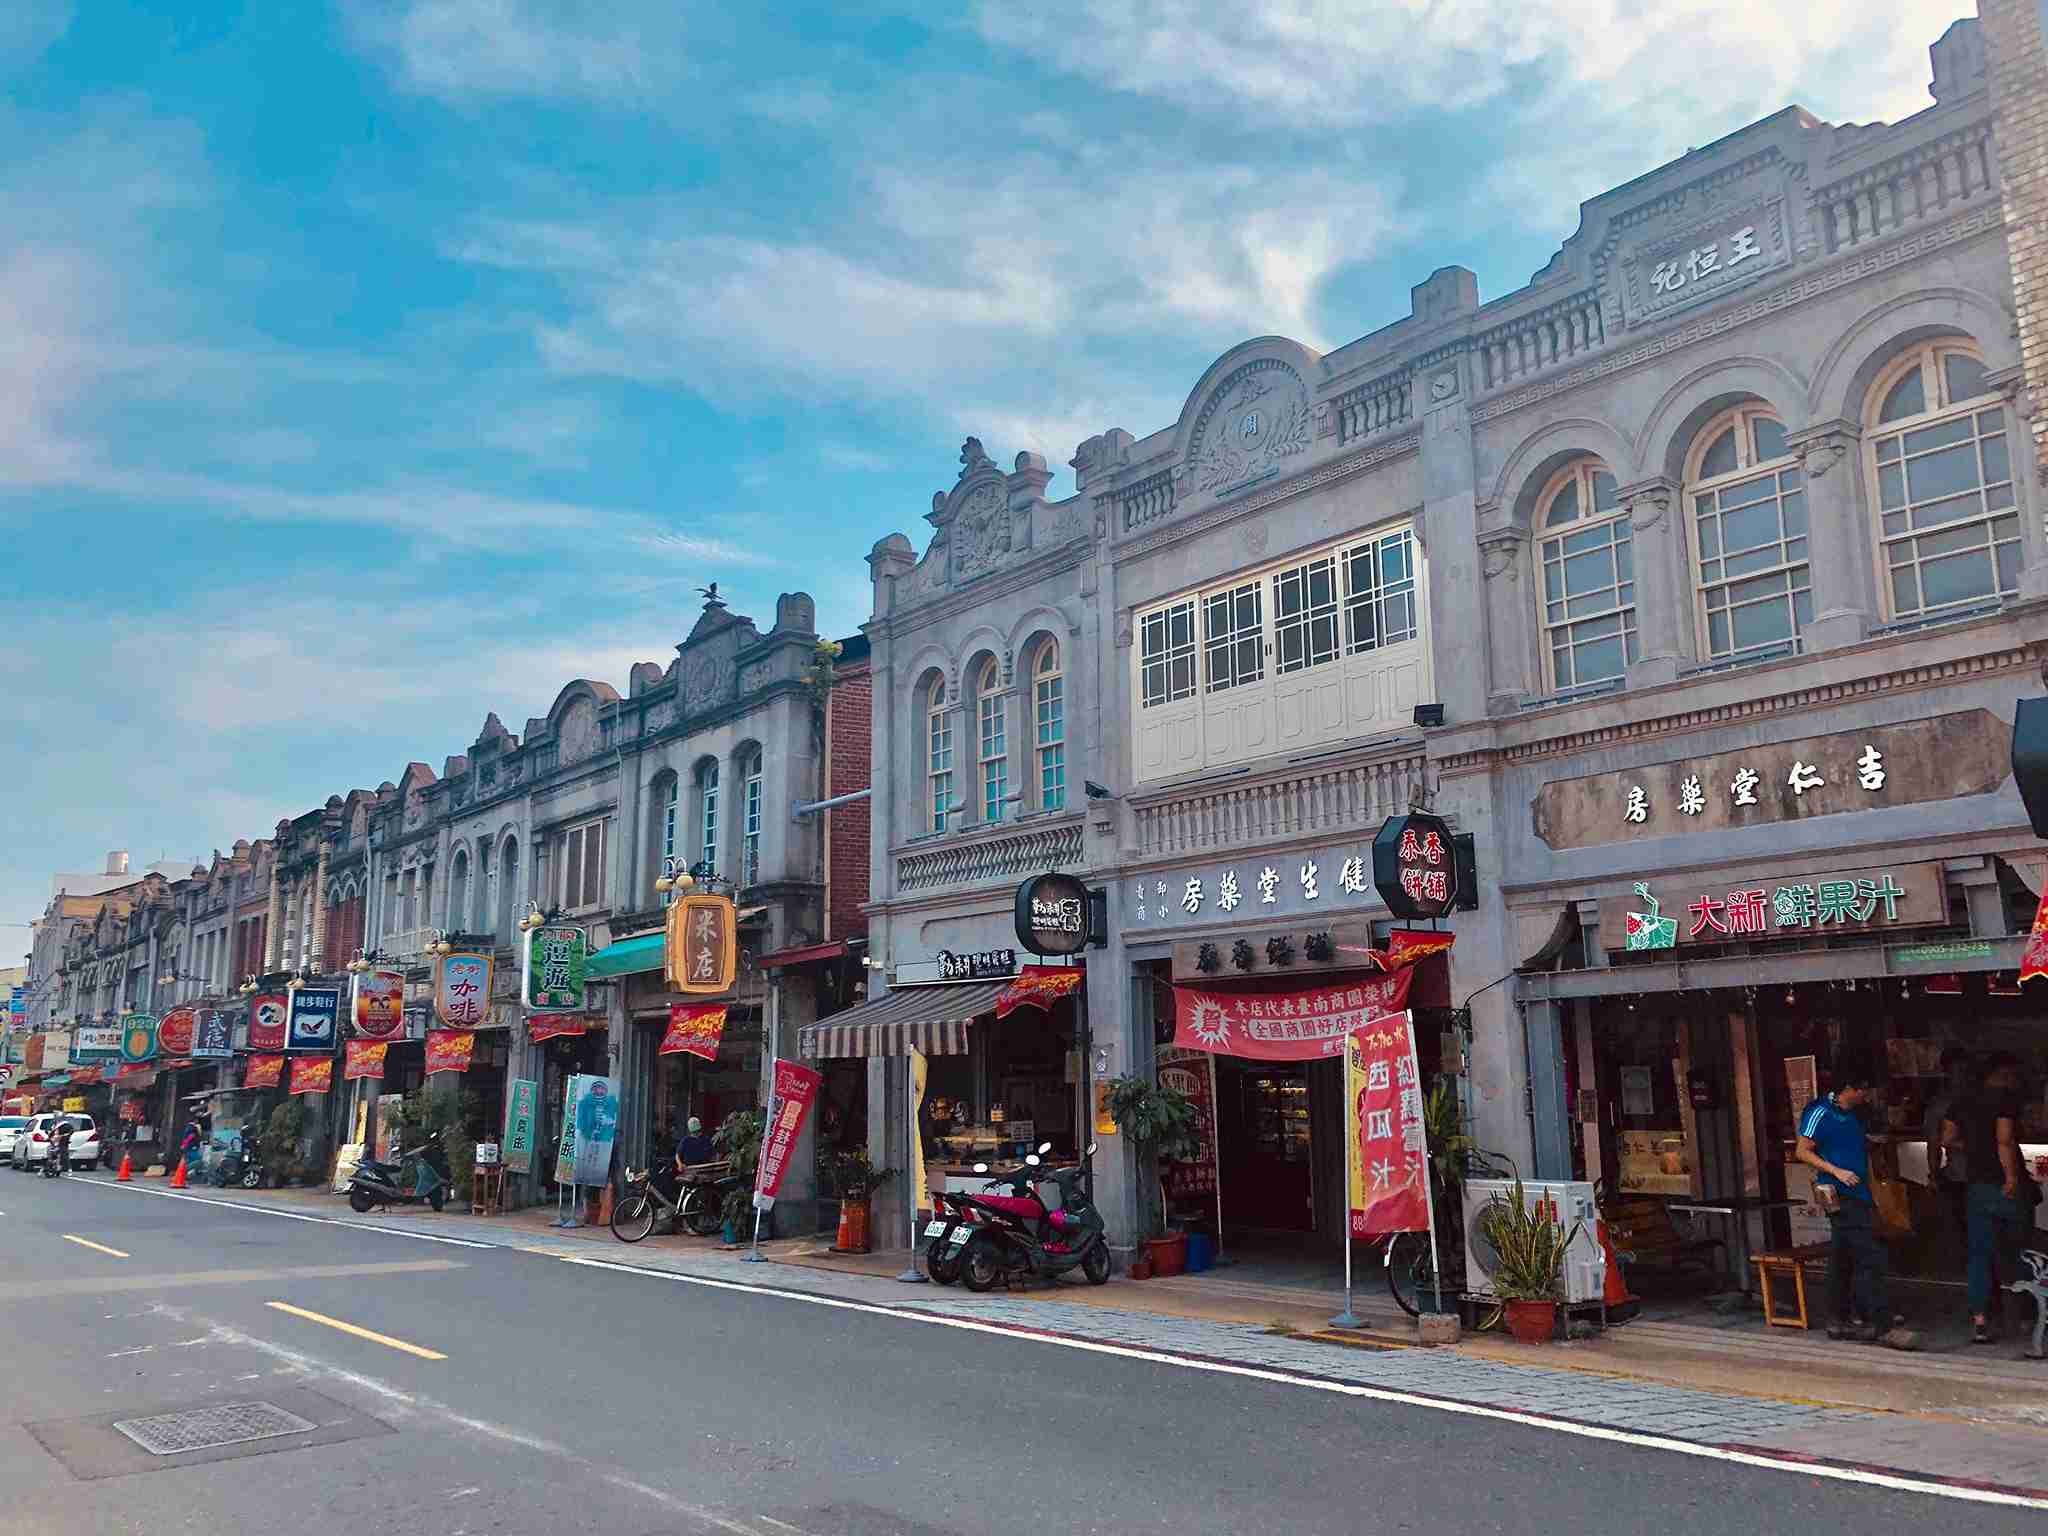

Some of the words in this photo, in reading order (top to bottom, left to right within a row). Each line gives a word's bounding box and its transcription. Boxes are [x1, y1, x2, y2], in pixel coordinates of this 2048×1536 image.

[1650, 226, 1761, 296] 王恒記
[1623, 745, 1887, 823] 吉仁堂藥房
[1180, 856, 1369, 914] 健生堂藥房
[1687, 874, 1906, 937] 大新鮮果汁
[450, 978, 478, 1019] 咖啡
[1367, 1060, 1396, 1191] 西瓜汁
